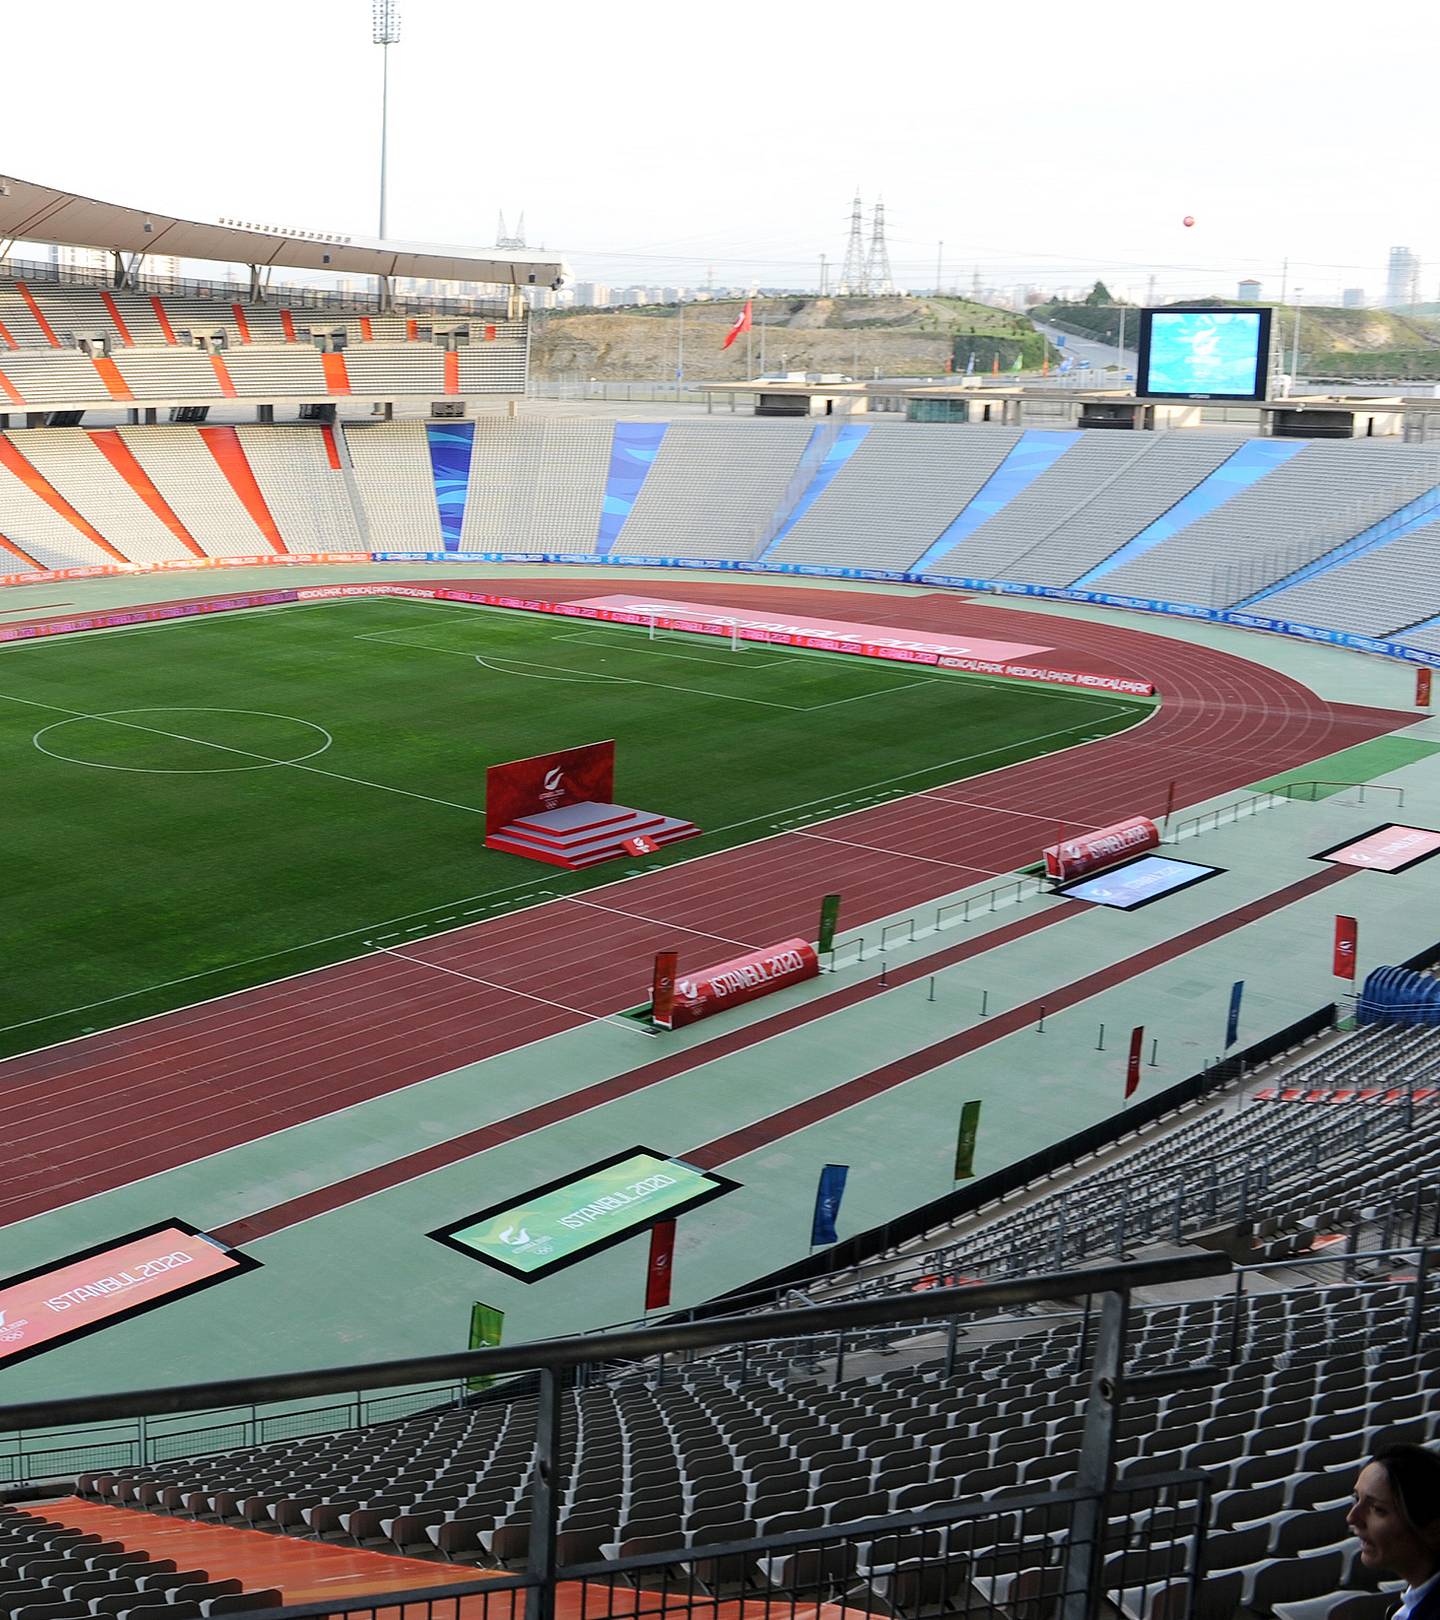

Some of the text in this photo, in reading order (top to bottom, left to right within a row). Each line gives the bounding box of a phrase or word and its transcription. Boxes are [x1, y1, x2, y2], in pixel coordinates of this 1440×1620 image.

[766, 950, 804, 977] 2020
[626, 1174, 677, 1197] 2020
[135, 1251, 193, 1278] 2020
